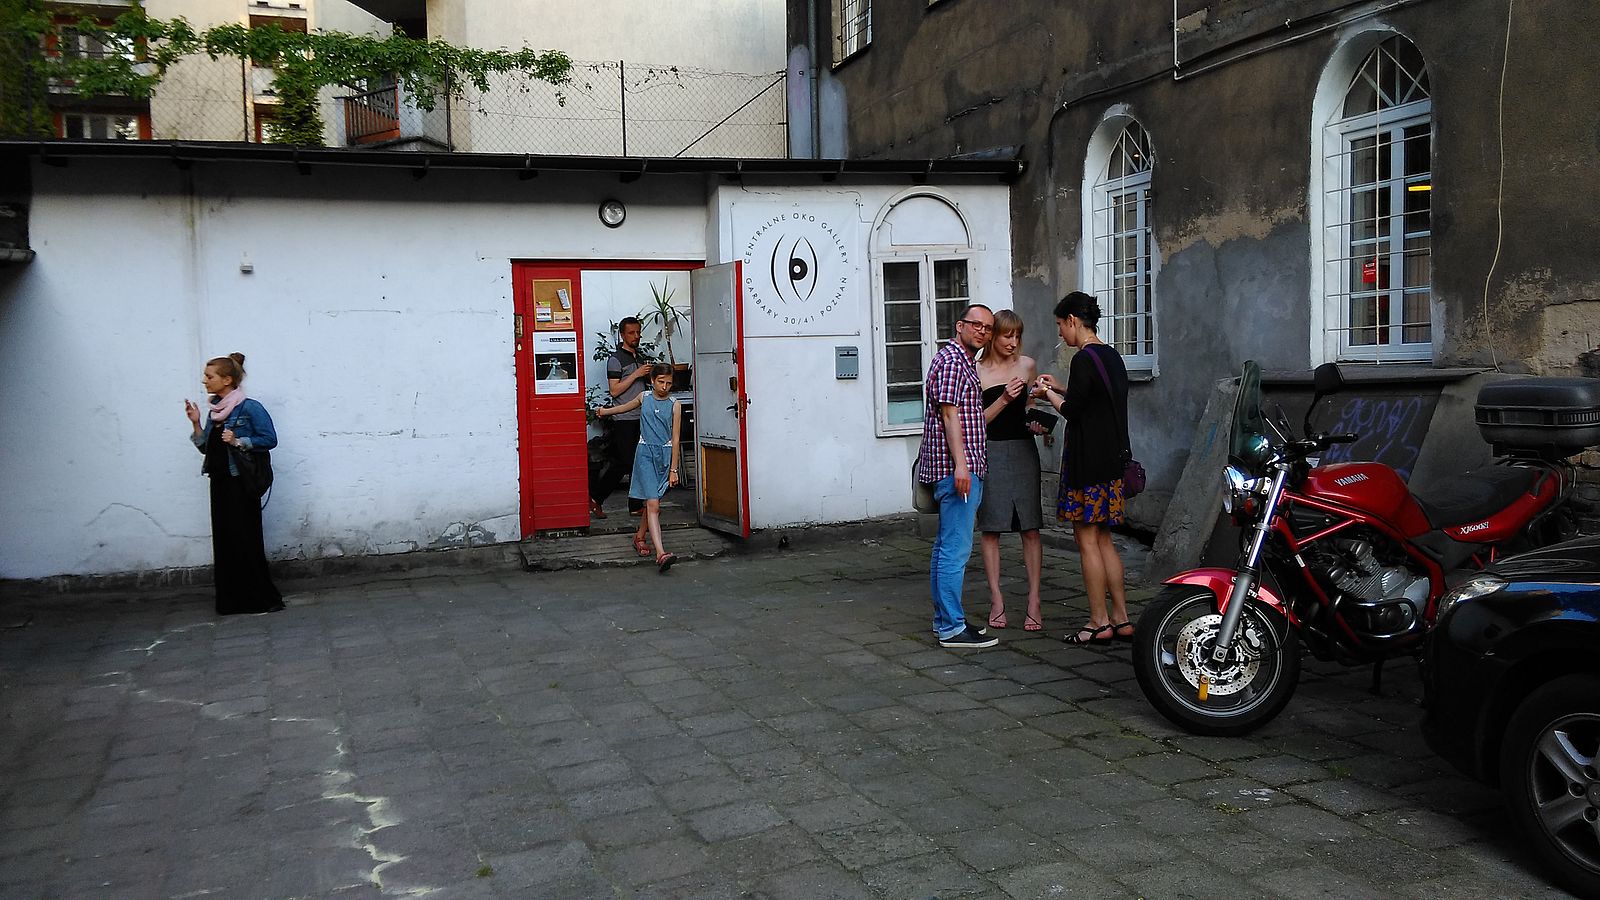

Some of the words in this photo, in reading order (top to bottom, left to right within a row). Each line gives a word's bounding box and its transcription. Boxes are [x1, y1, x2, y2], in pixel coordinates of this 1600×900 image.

[743, 214, 786, 265] CENTRALNE
[792, 212, 815, 222] OKO
[821, 222, 849, 265] GALLERY
[745, 277, 778, 319] GARBARY
[783, 316, 815, 325] 30/41
[820, 277, 847, 317] POZNAŃ
[1334, 473, 1369, 487] YAMAHA
